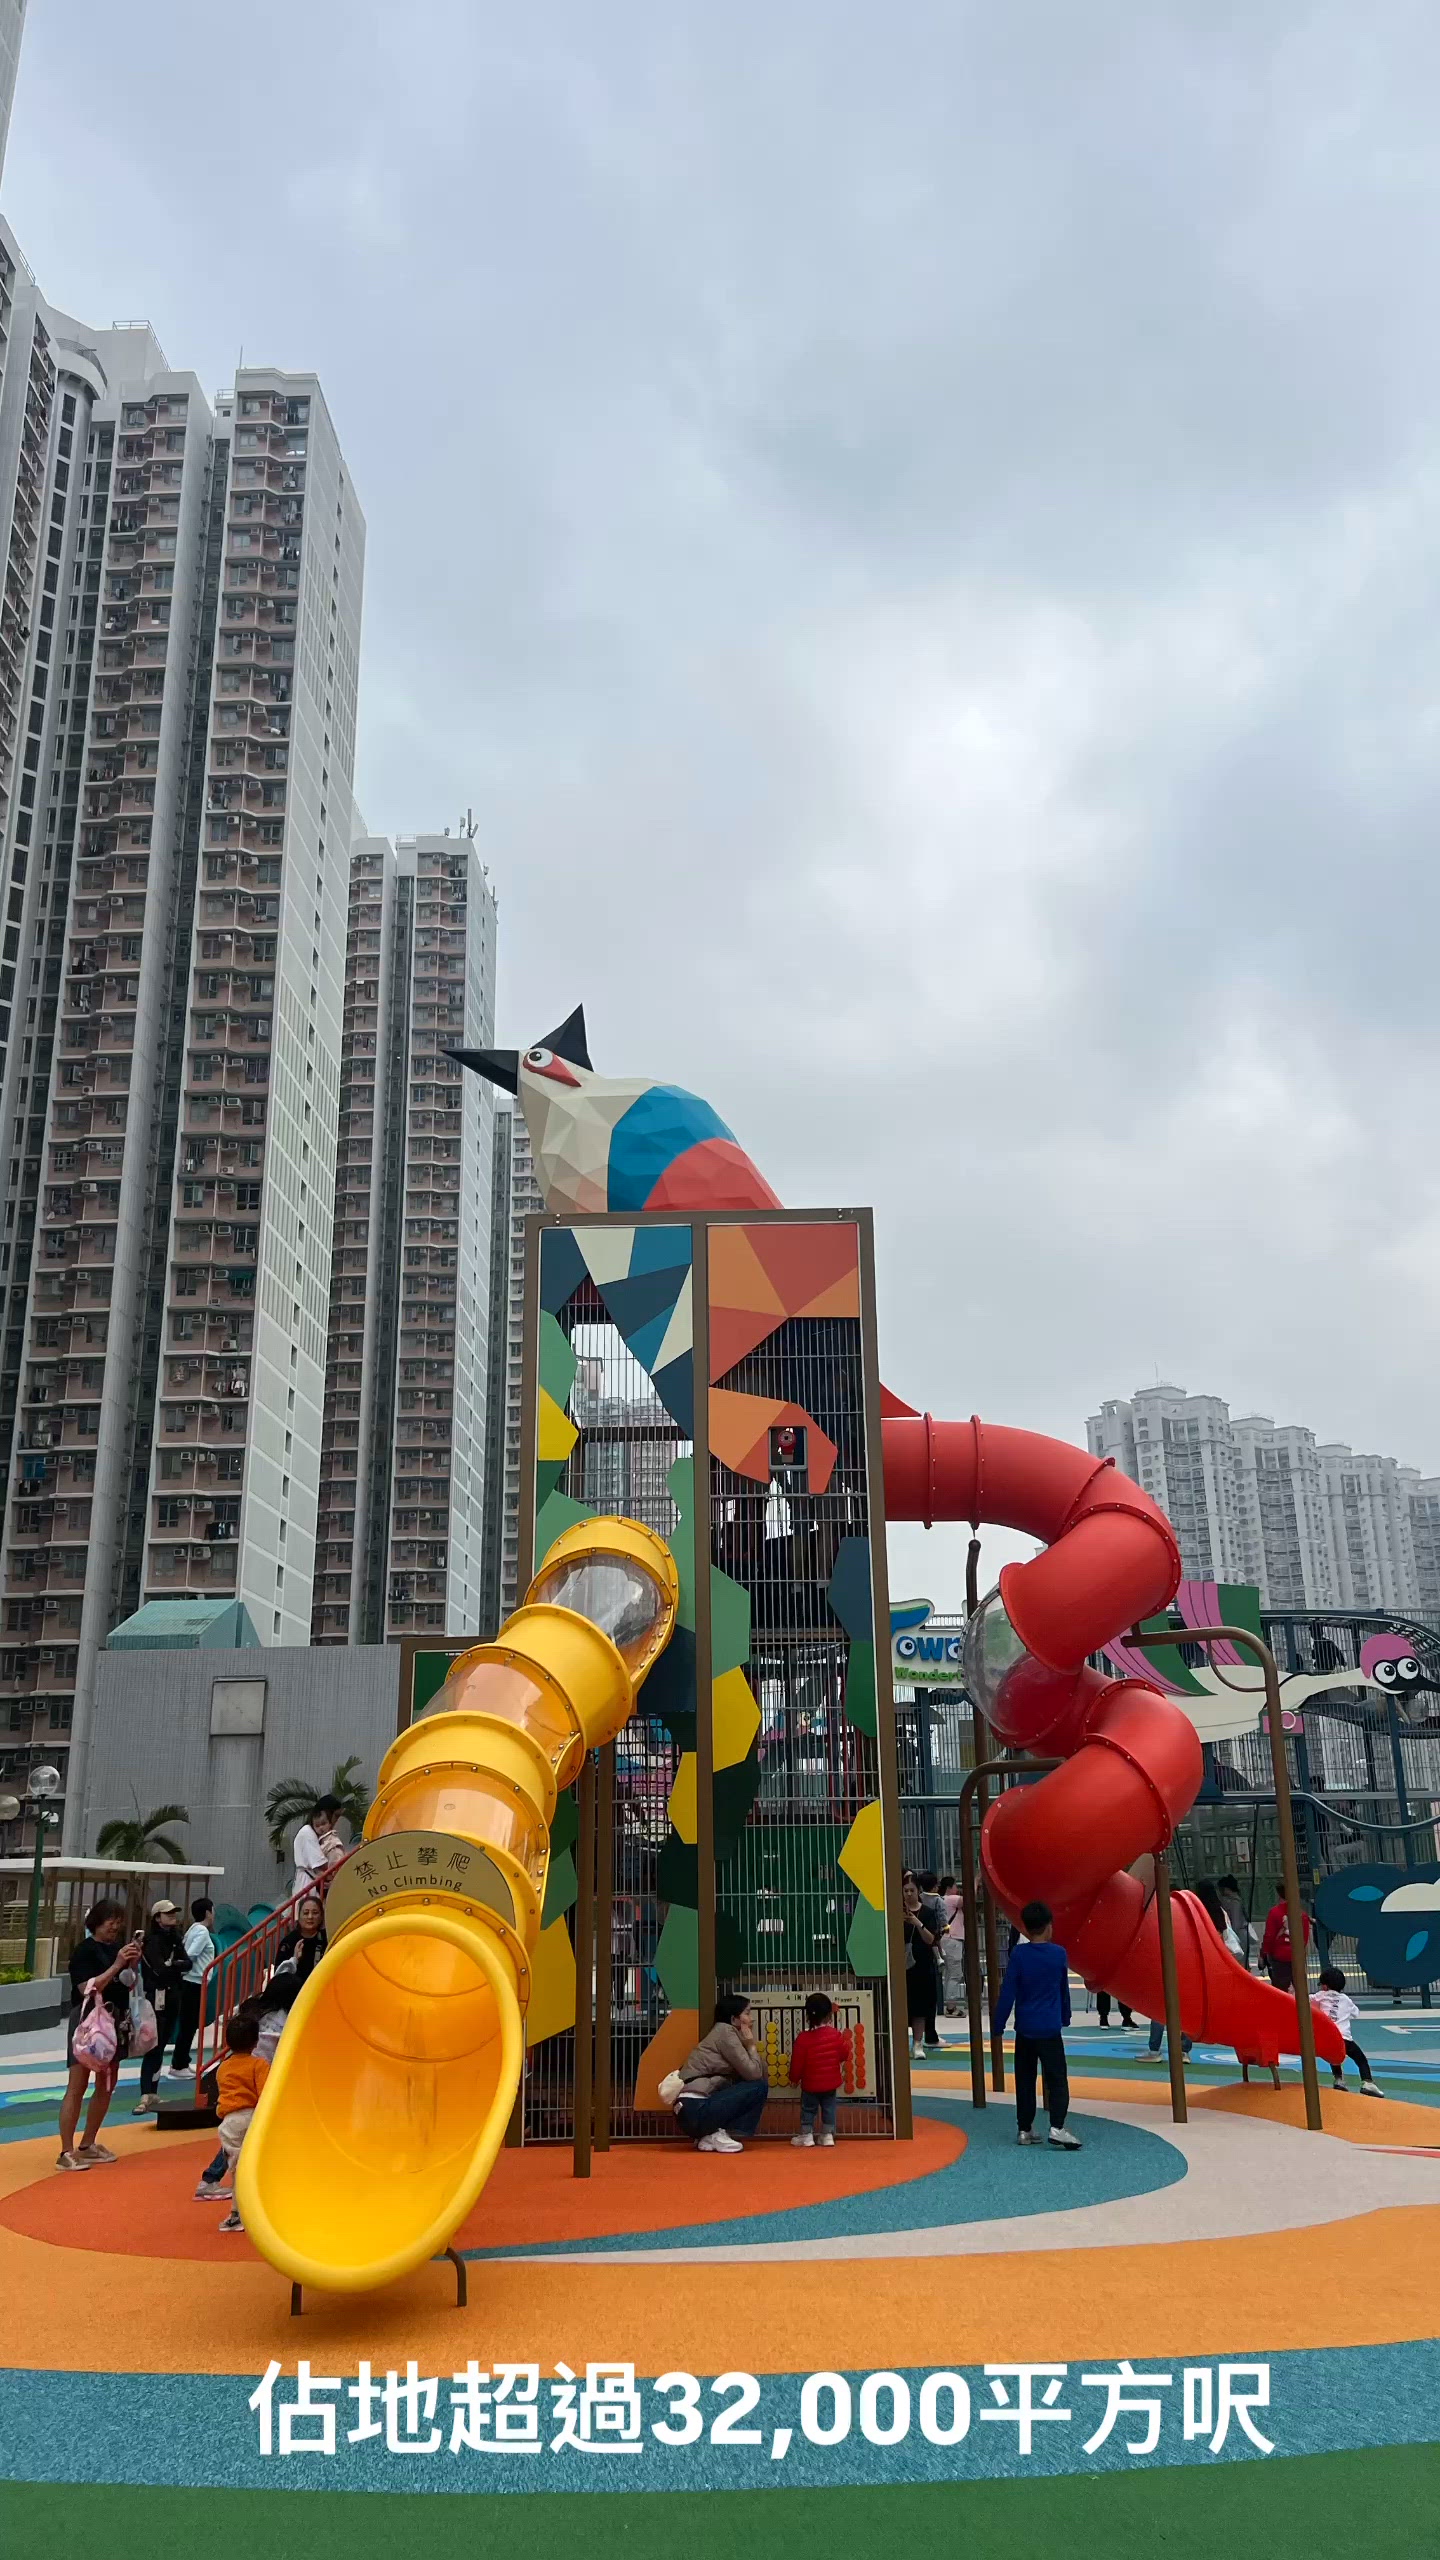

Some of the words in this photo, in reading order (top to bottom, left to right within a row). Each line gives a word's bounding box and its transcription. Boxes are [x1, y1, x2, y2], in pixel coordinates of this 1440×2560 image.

[353, 1847, 471, 1884] 禁止攀爬
[367, 1882, 389, 1898] No
[393, 1873, 463, 1892] Climbing
